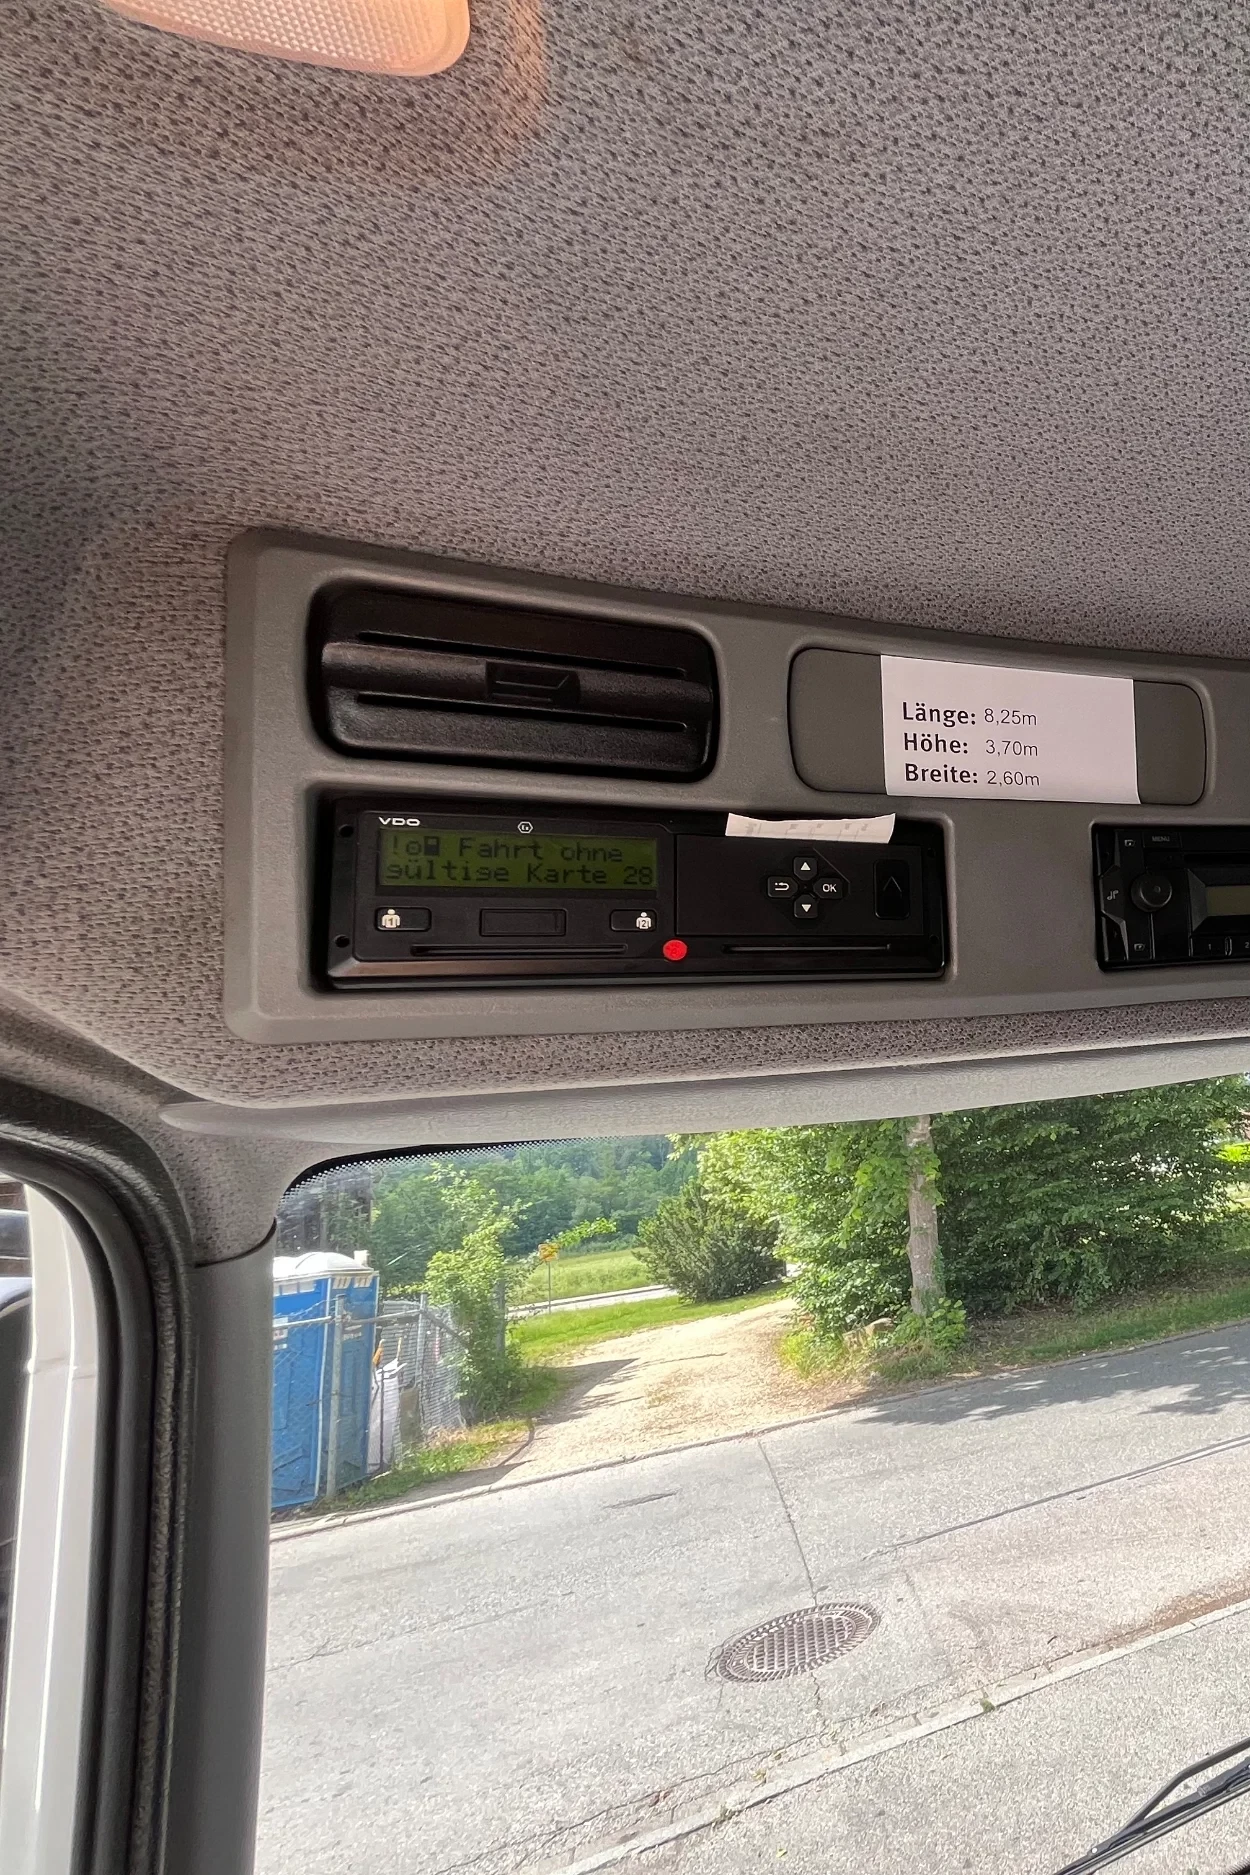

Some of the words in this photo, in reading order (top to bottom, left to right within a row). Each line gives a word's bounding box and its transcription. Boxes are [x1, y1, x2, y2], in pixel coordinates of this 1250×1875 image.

[902, 701, 977, 728] Länge:
[984, 708, 1038, 726] 8,25m
[903, 732, 969, 755] Höhe:
[985, 739, 1039, 757] 3,70m
[904, 763, 979, 784] Breite:
[986, 770, 1040, 787] 2,60m
[378, 817, 421, 826] VDO
[459, 837, 545, 861] Fahrt
[560, 841, 624, 863] ohne
[385, 860, 510, 882] gültige
[526, 866, 608, 885] Karte
[622, 866, 654, 886] 28
[822, 883, 837, 893] OK
